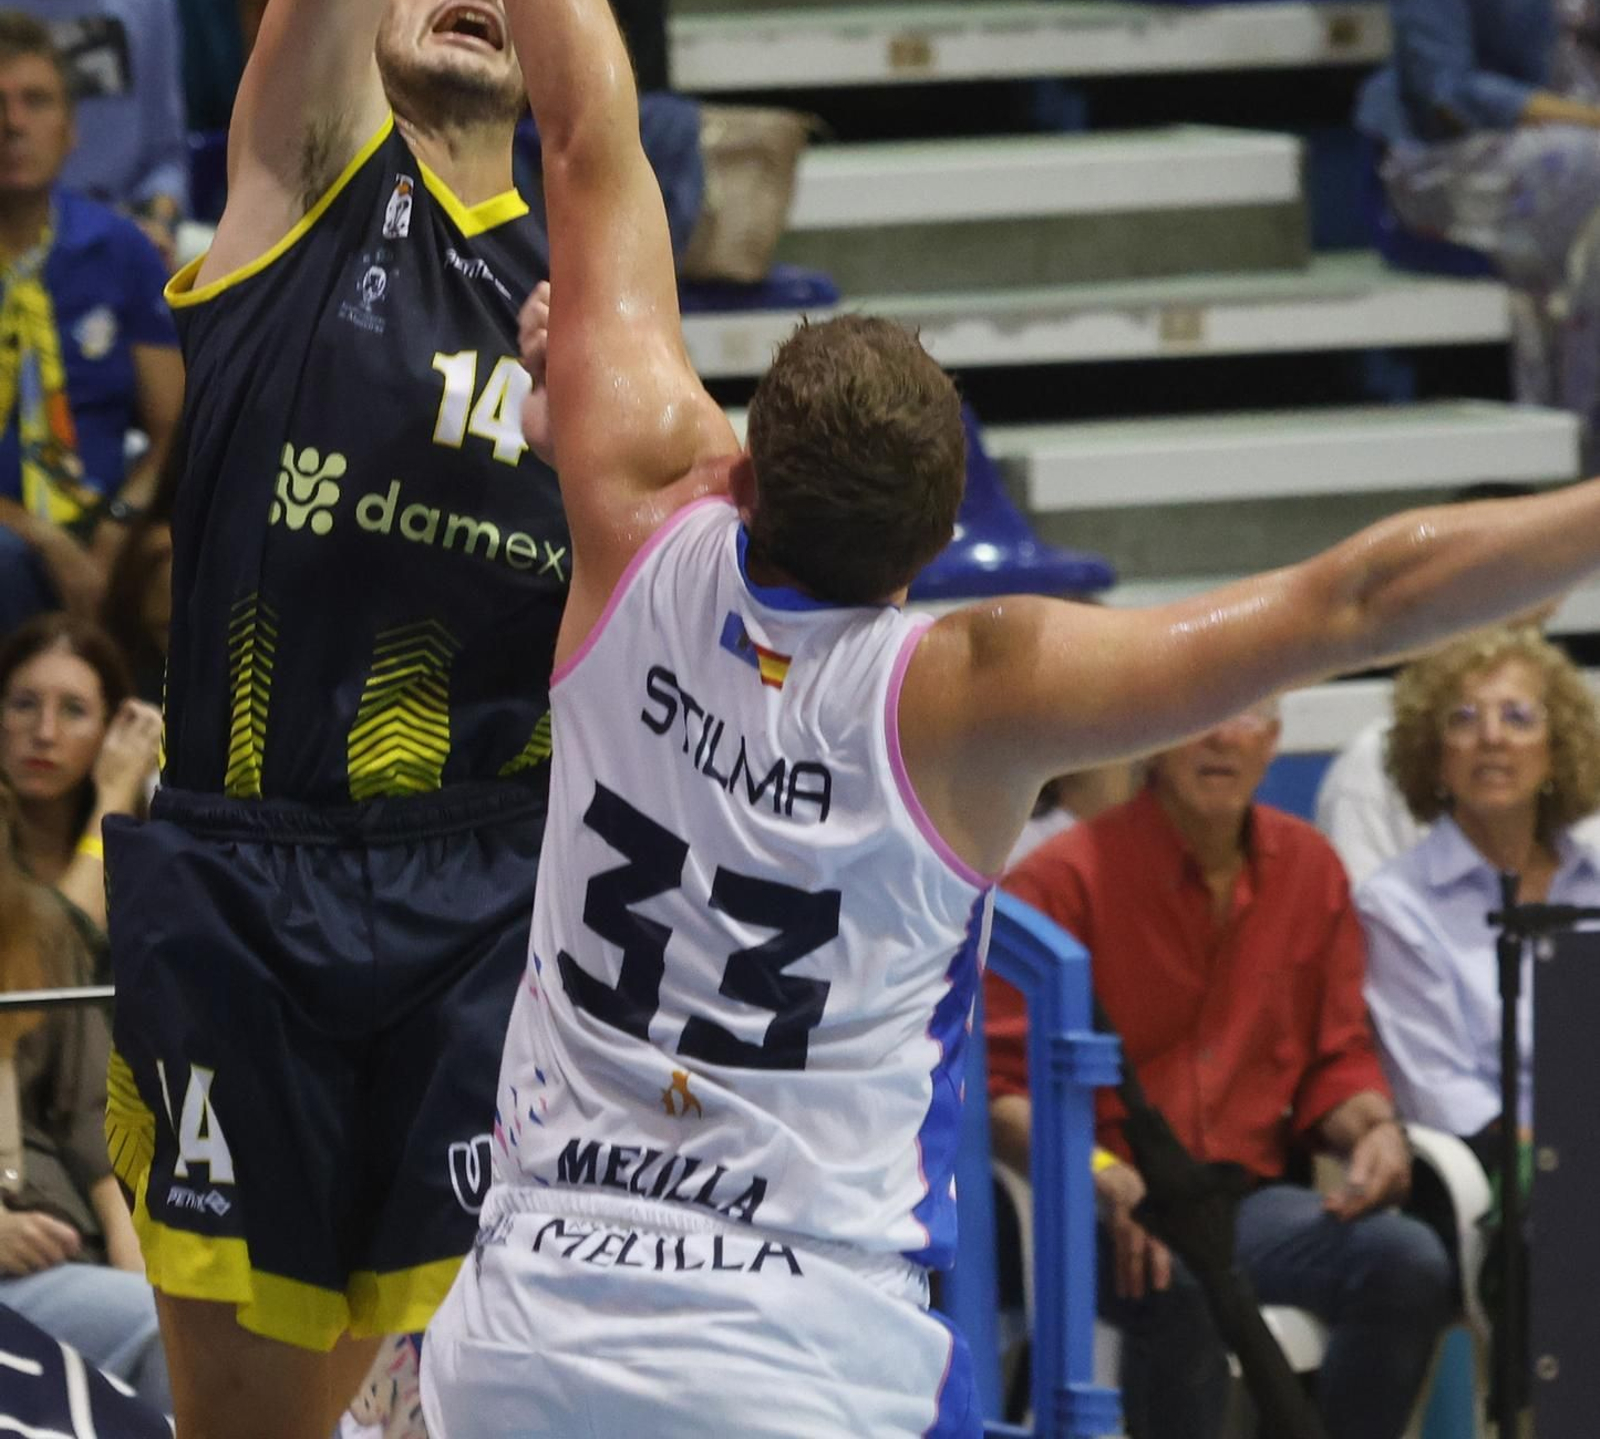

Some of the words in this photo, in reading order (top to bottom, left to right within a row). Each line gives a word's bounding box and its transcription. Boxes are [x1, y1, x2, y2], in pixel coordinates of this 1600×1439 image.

[432, 350, 534, 467] 14
[355, 480, 567, 582] damex
[641, 664, 833, 824] STILMA
[557, 779, 842, 1071] 33
